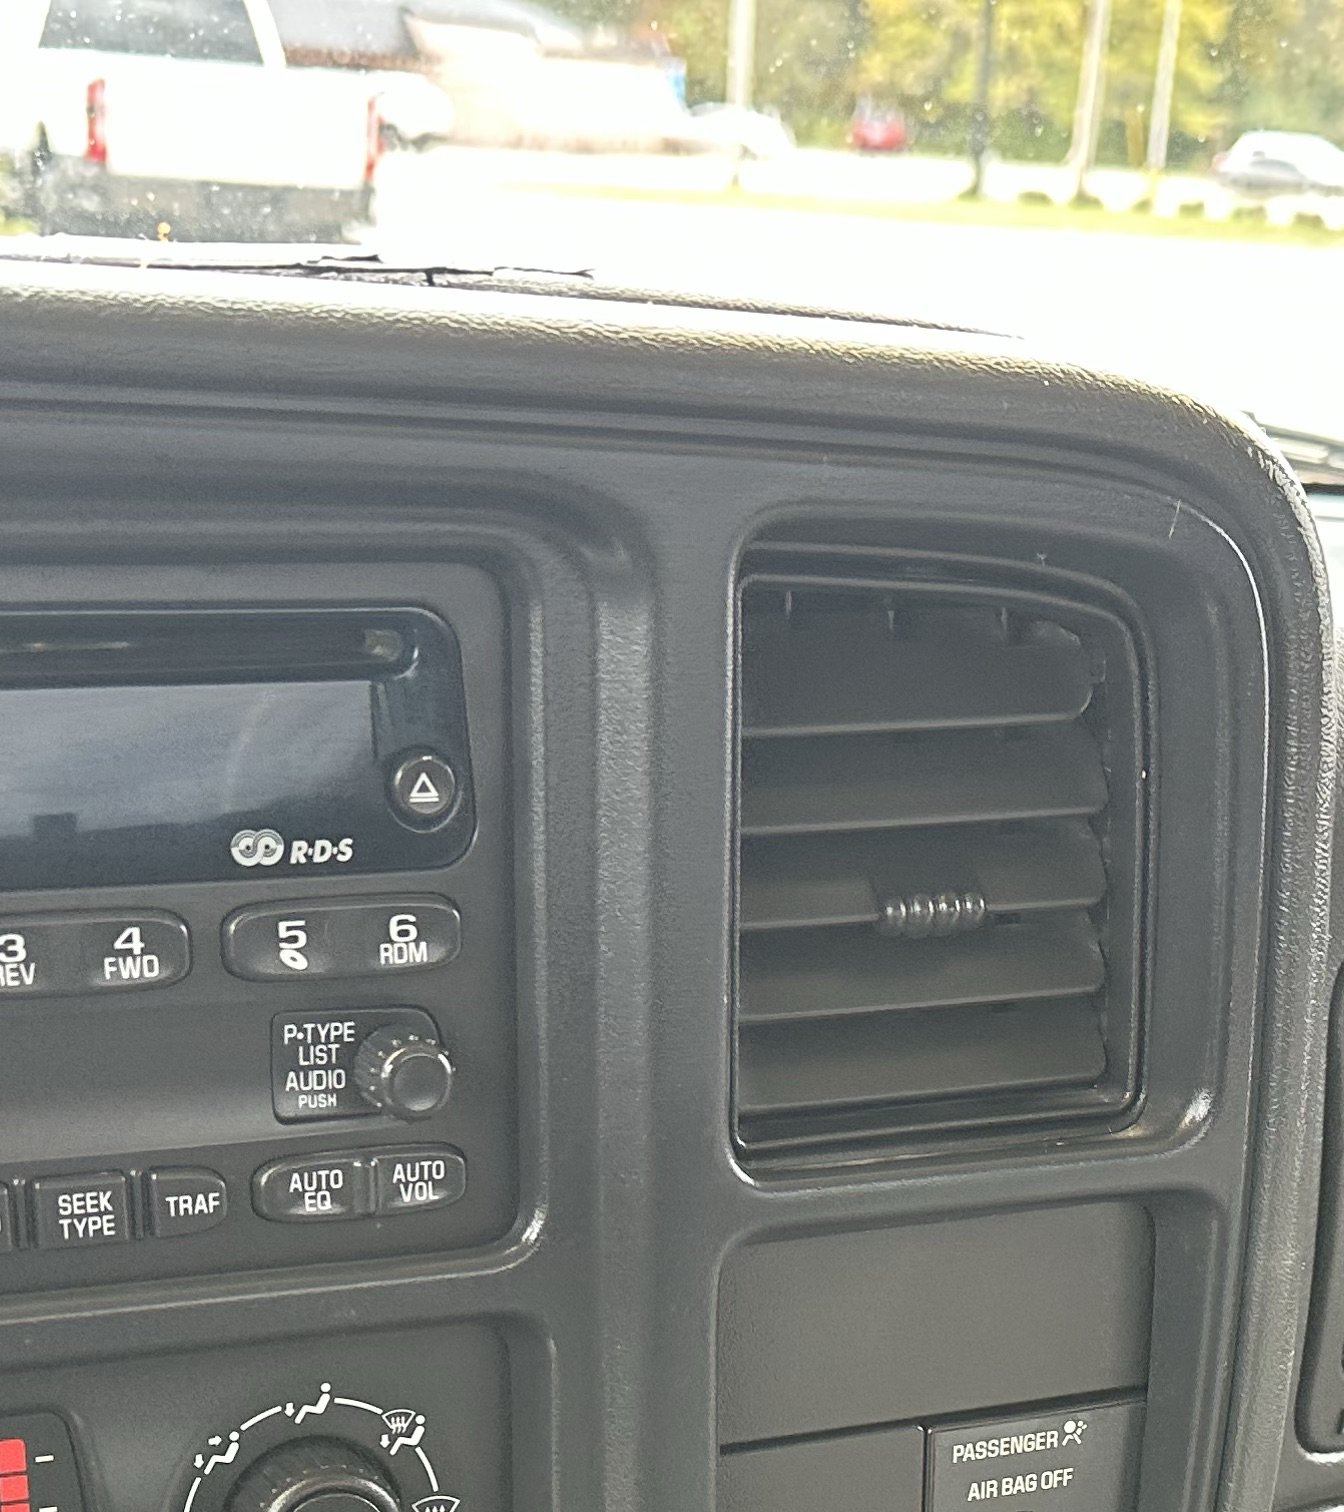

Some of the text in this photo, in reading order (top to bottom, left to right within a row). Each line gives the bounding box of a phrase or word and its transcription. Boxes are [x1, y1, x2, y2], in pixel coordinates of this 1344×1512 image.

[278, 920, 307, 949] 5
[389, 914, 418, 942] 6
[113, 926, 146, 955] 4
[379, 941, 429, 965] RDM
[103, 954, 160, 980] FWD
[298, 1044, 341, 1066] LIST
[284, 1068, 346, 1092] AUDIO
[297, 1093, 337, 1109] PUSH
[289, 1169, 344, 1192] AUTO
[392, 1160, 446, 1184] AUTO
[57, 1190, 114, 1215] SEEK
[166, 1192, 220, 1216] TRAF
[304, 1191, 332, 1212] EQ
[399, 1181, 439, 1203] VOL
[58, 1215, 116, 1239] TYPE
[952, 1430, 1059, 1464] PASSENGER
[967, 1467, 1074, 1502] AIR BAG OFF
